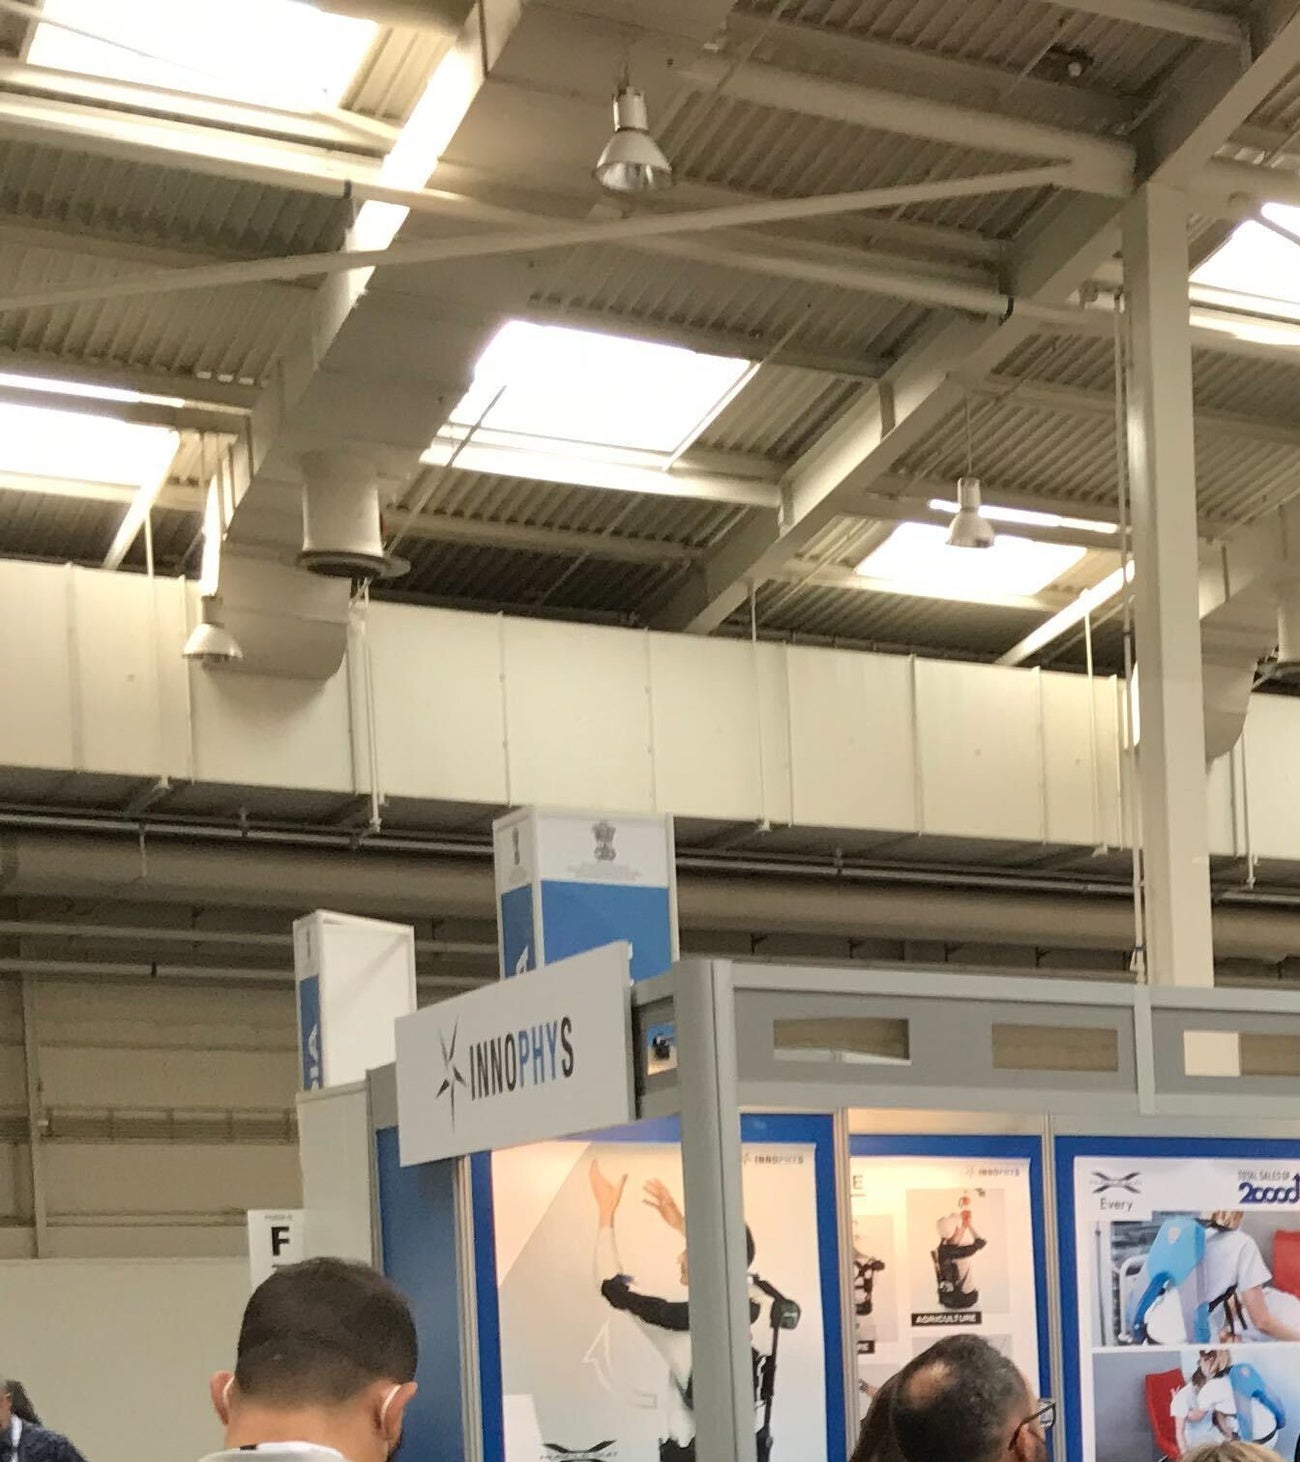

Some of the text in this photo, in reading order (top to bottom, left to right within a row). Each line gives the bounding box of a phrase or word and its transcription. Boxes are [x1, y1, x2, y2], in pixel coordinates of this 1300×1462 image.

[473, 1017, 574, 1100] INNOPHYS
[1100, 1198, 1134, 1212] Every
[271, 1226, 290, 1256] F
